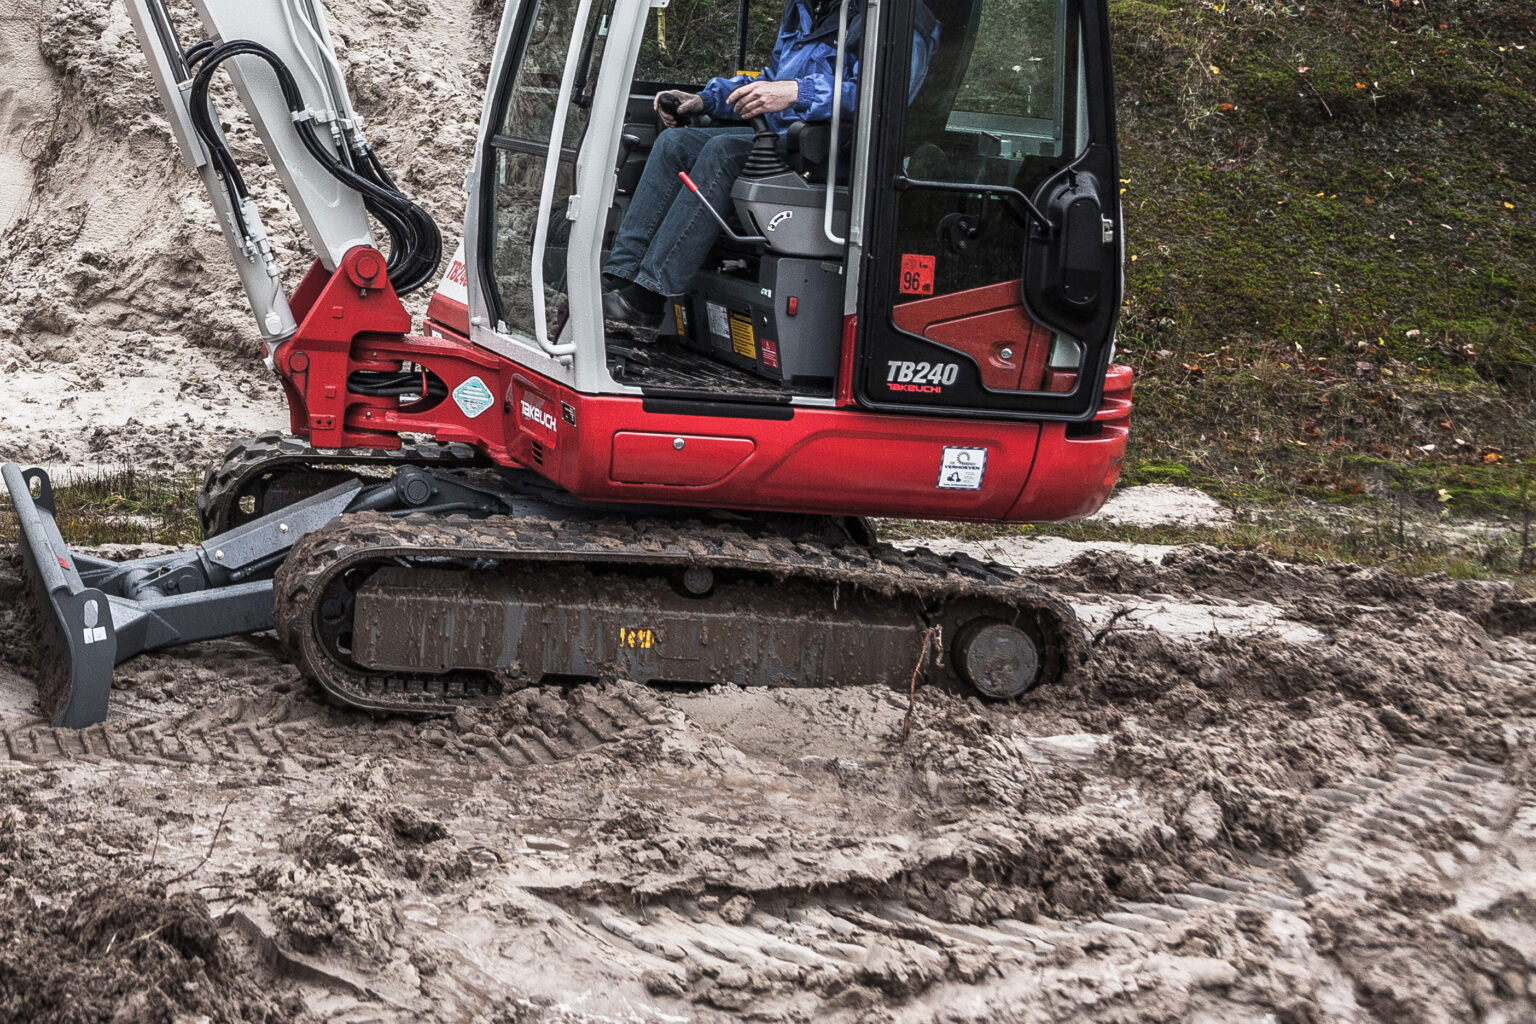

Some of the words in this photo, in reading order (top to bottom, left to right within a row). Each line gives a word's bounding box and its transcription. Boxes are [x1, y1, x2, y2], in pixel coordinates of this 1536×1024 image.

[904, 271, 920, 291] 96
[887, 360, 959, 386] TB240
[887, 383, 941, 393] TAKEUCHI
